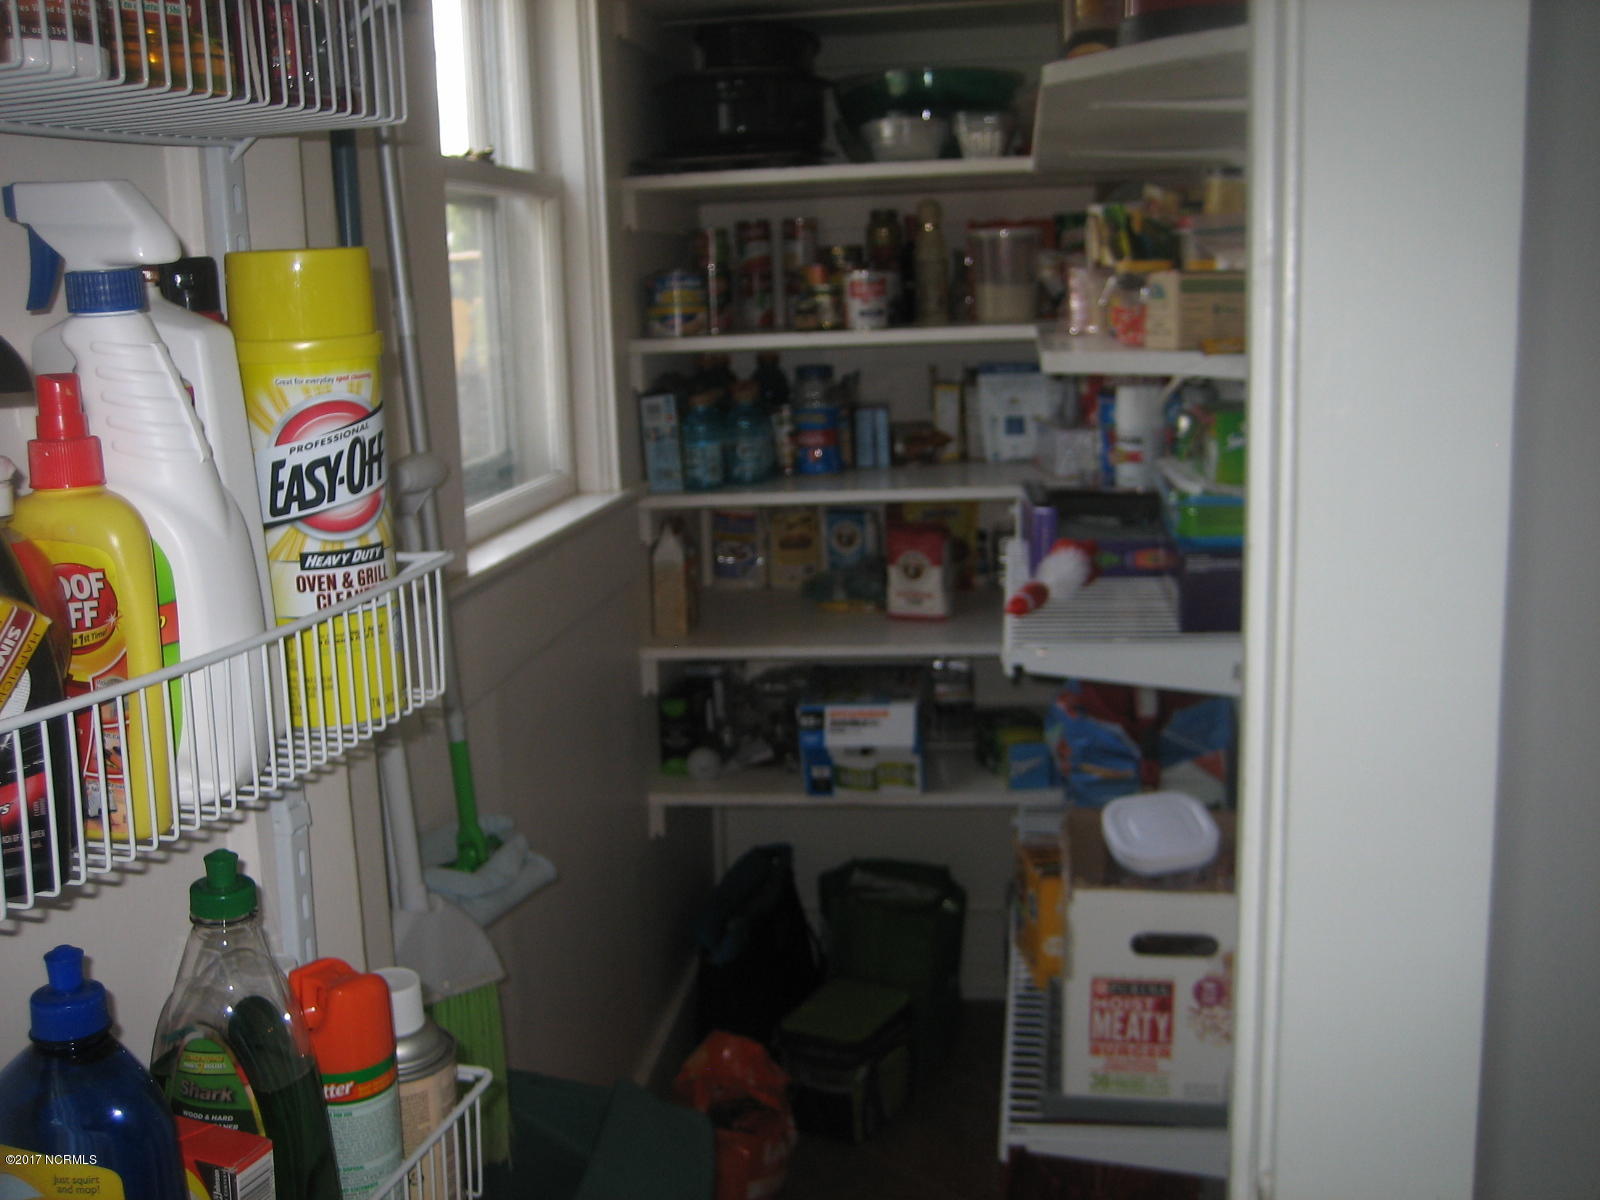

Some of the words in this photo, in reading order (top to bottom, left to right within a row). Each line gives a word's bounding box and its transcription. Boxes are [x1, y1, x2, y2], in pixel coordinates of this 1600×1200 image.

[289, 421, 369, 455] PROFESSIONAL
[269, 430, 383, 517] EASY-OFF
[305, 553, 349, 568] HEAVY
[351, 545, 381, 562] DUTY
[58, 571, 105, 600] OOF
[296, 573, 337, 592] OVEN
[342, 571, 353, 589] &
[357, 563, 388, 586] GRILL
[316, 584, 378, 610] CLEA
[1092, 1009, 1169, 1043] MEATY
[181, 1077, 233, 1102] Shark
[324, 1081, 355, 1100] tter
[182, 1109, 203, 1120] WOOD
[211, 1113, 233, 1122] HARD
